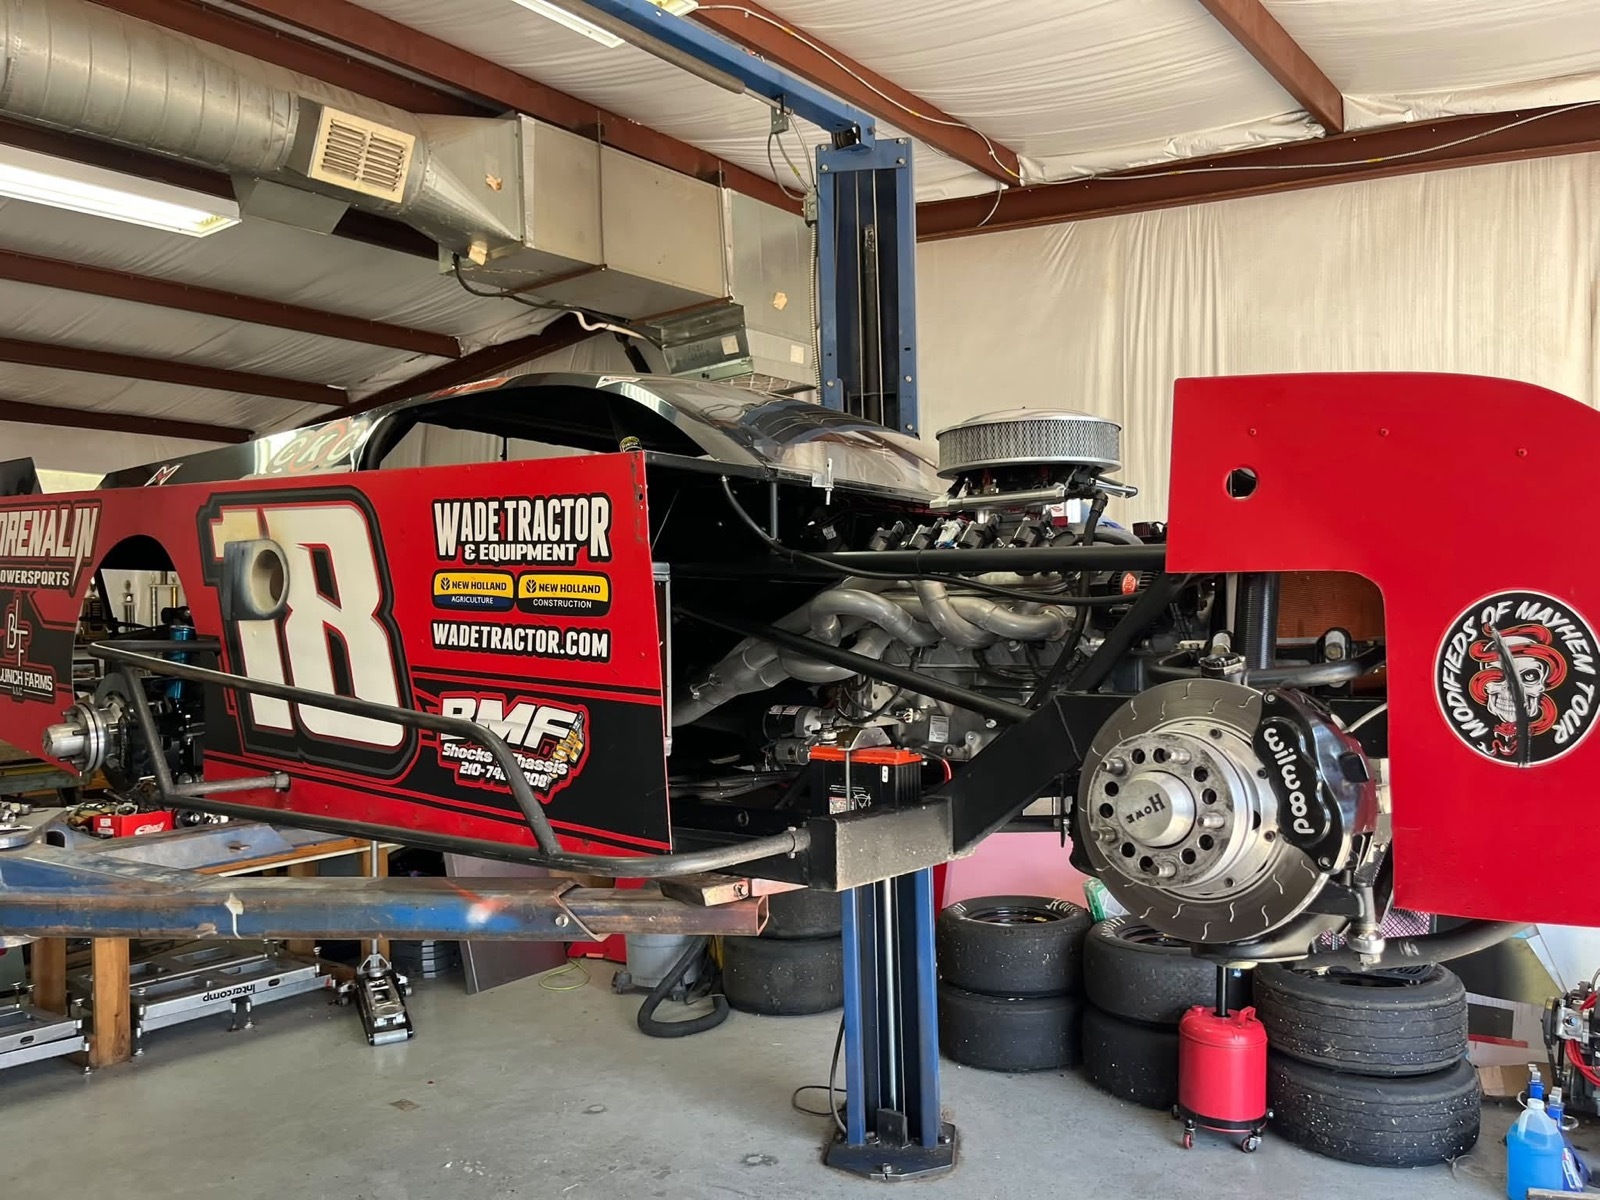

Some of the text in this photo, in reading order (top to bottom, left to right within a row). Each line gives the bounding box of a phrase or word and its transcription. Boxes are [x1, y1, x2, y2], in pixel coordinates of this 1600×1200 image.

[434, 497, 609, 557] WADE TRACTOR
[464, 543, 577, 562] & EQUIPMENT
[451, 581, 507, 591] NEW HOLLAND
[451, 596, 494, 605] AGRICULTURE
[538, 584, 601, 594] NEW HOLLAND
[533, 598, 592, 609] CONSTRUCTION
[213, 506, 404, 747] 18
[432, 622, 608, 658] WADETRACTOR.COM
[24, 671, 53, 692] FARMS
[1442, 601, 1596, 744] MODIFIEDS OF MAYHEM TOUR
[440, 698, 578, 749] BMF
[442, 743, 493, 762] Shocks
[513, 752, 568, 775] hassis
[1263, 727, 1315, 834] wilwood
